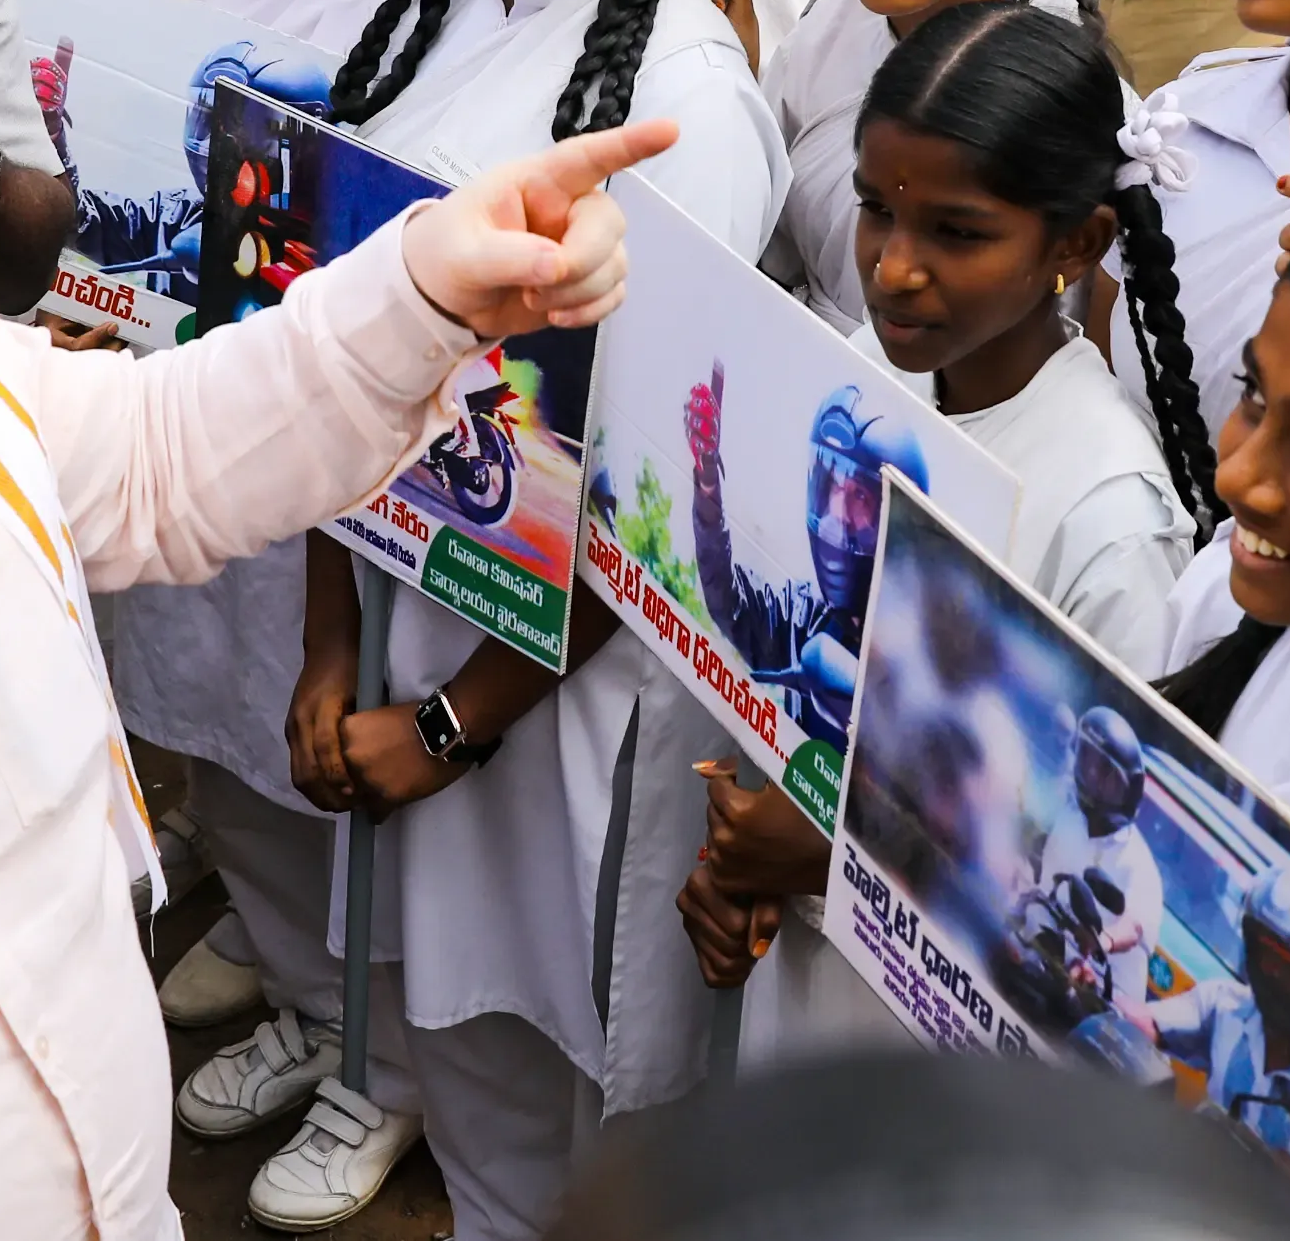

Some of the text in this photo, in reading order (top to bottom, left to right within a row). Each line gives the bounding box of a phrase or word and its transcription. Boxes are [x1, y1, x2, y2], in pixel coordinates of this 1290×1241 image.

[391, 501, 429, 543] నేరం
[448, 538, 489, 577] రవాణా
[491, 563, 544, 608] కమిషనర్
[429, 567, 561, 656] కార్యాలయం ఖైరతాబాద్
[813, 751, 840, 792] రవా
[920, 934, 993, 1033] ధారణ
